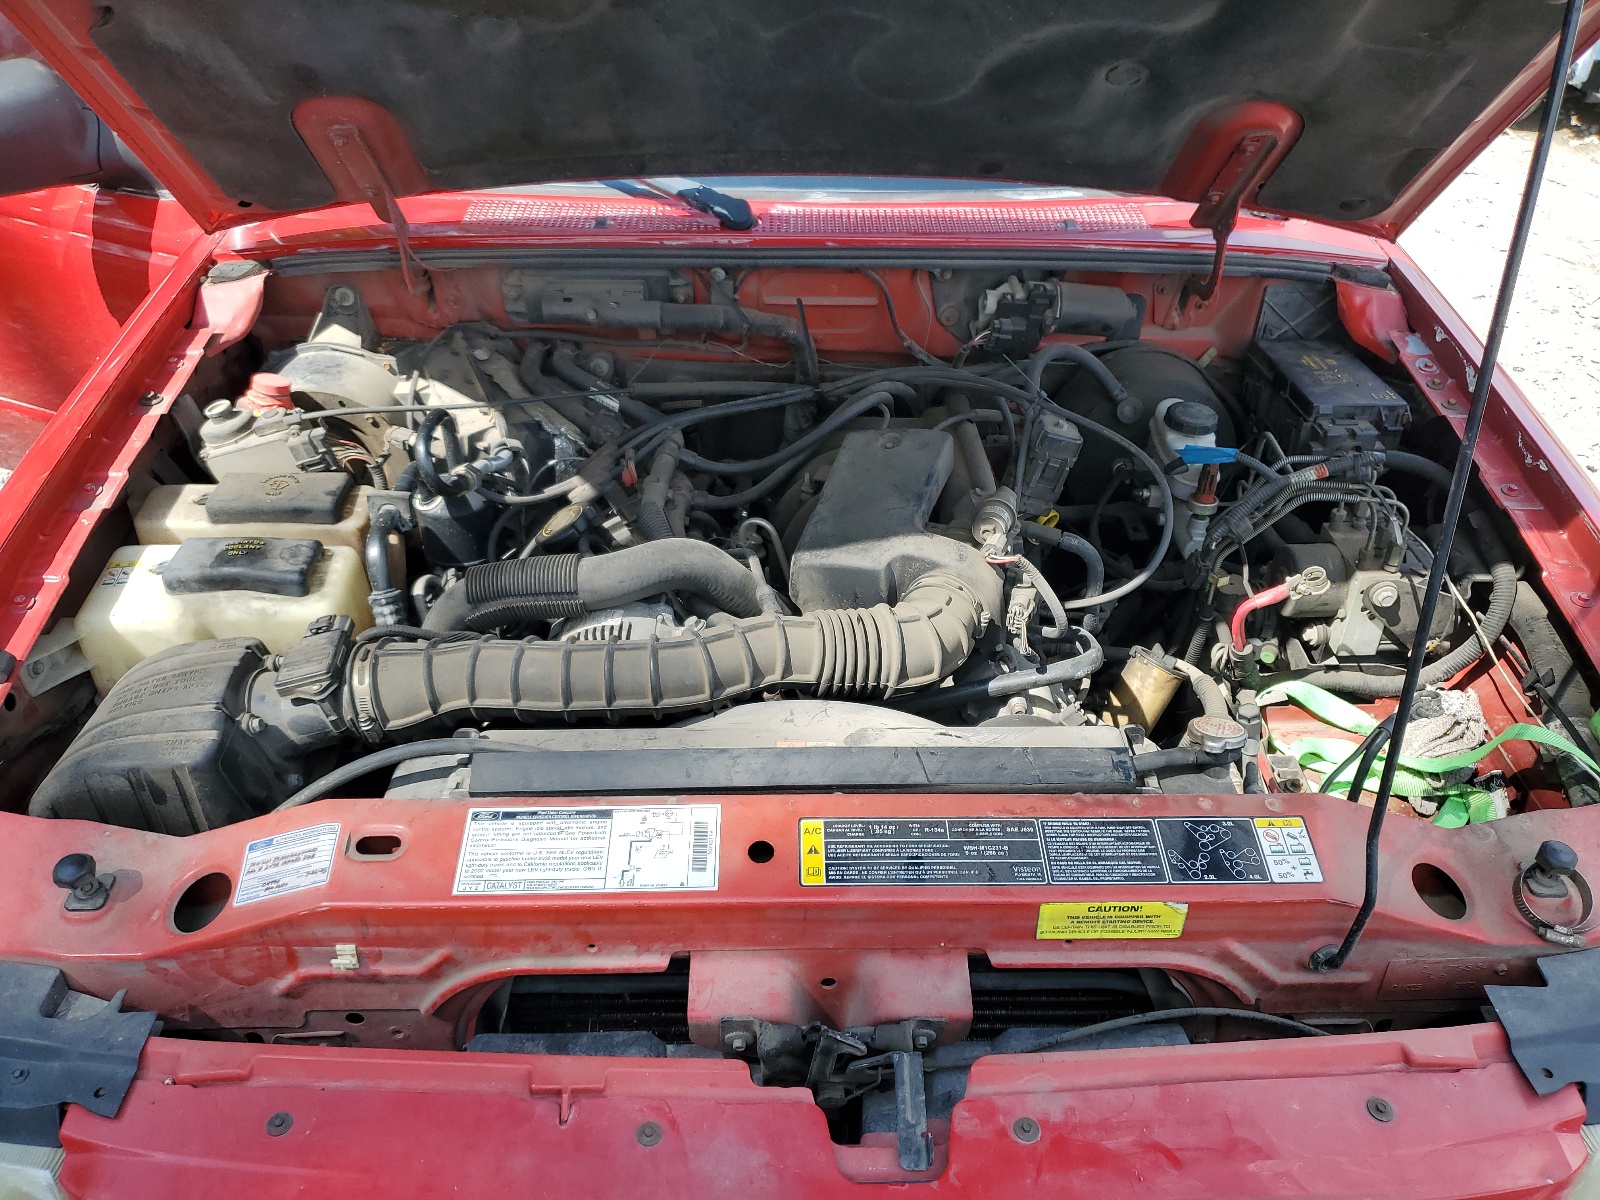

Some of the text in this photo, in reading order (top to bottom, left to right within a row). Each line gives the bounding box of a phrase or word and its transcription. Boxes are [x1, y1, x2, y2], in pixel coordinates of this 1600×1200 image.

[803, 827, 823, 835] A/C
[1273, 857, 1291, 866] 50%
[1012, 865, 1042, 874] Visteon
[1277, 871, 1296, 879] 50%
[486, 881, 523, 890] CATALYST
[1087, 905, 1144, 913] CAUTION!
